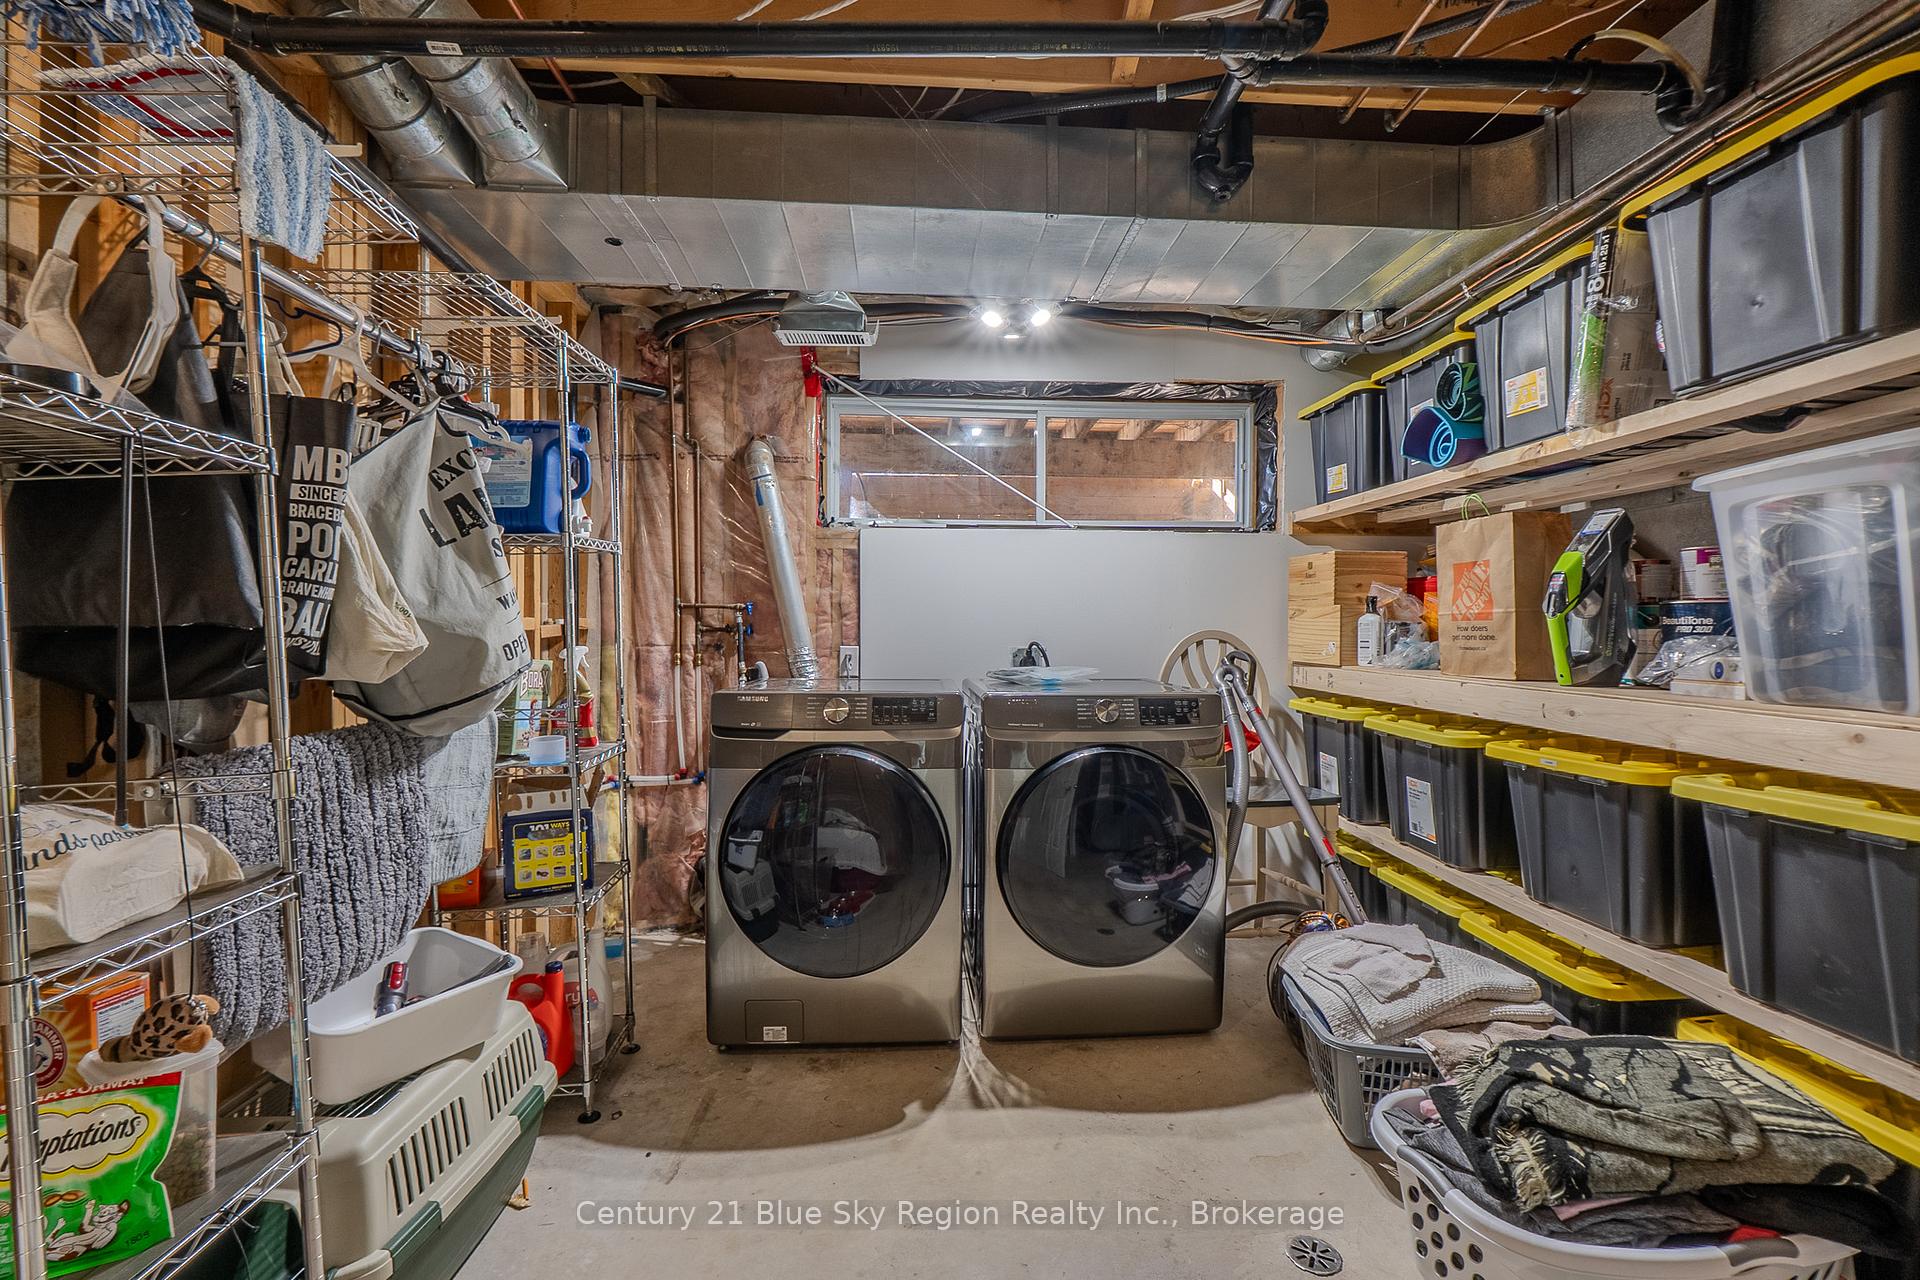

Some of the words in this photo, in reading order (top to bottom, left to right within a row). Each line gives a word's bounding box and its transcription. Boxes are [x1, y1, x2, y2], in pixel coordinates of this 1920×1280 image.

[298, 485, 339, 502] SINCE
[1662, 616, 1714, 625] BeautiTone
[1675, 625, 1692, 633] PRO
[1693, 625, 1714, 633] 300
[550, 821, 570, 830] WAYS
